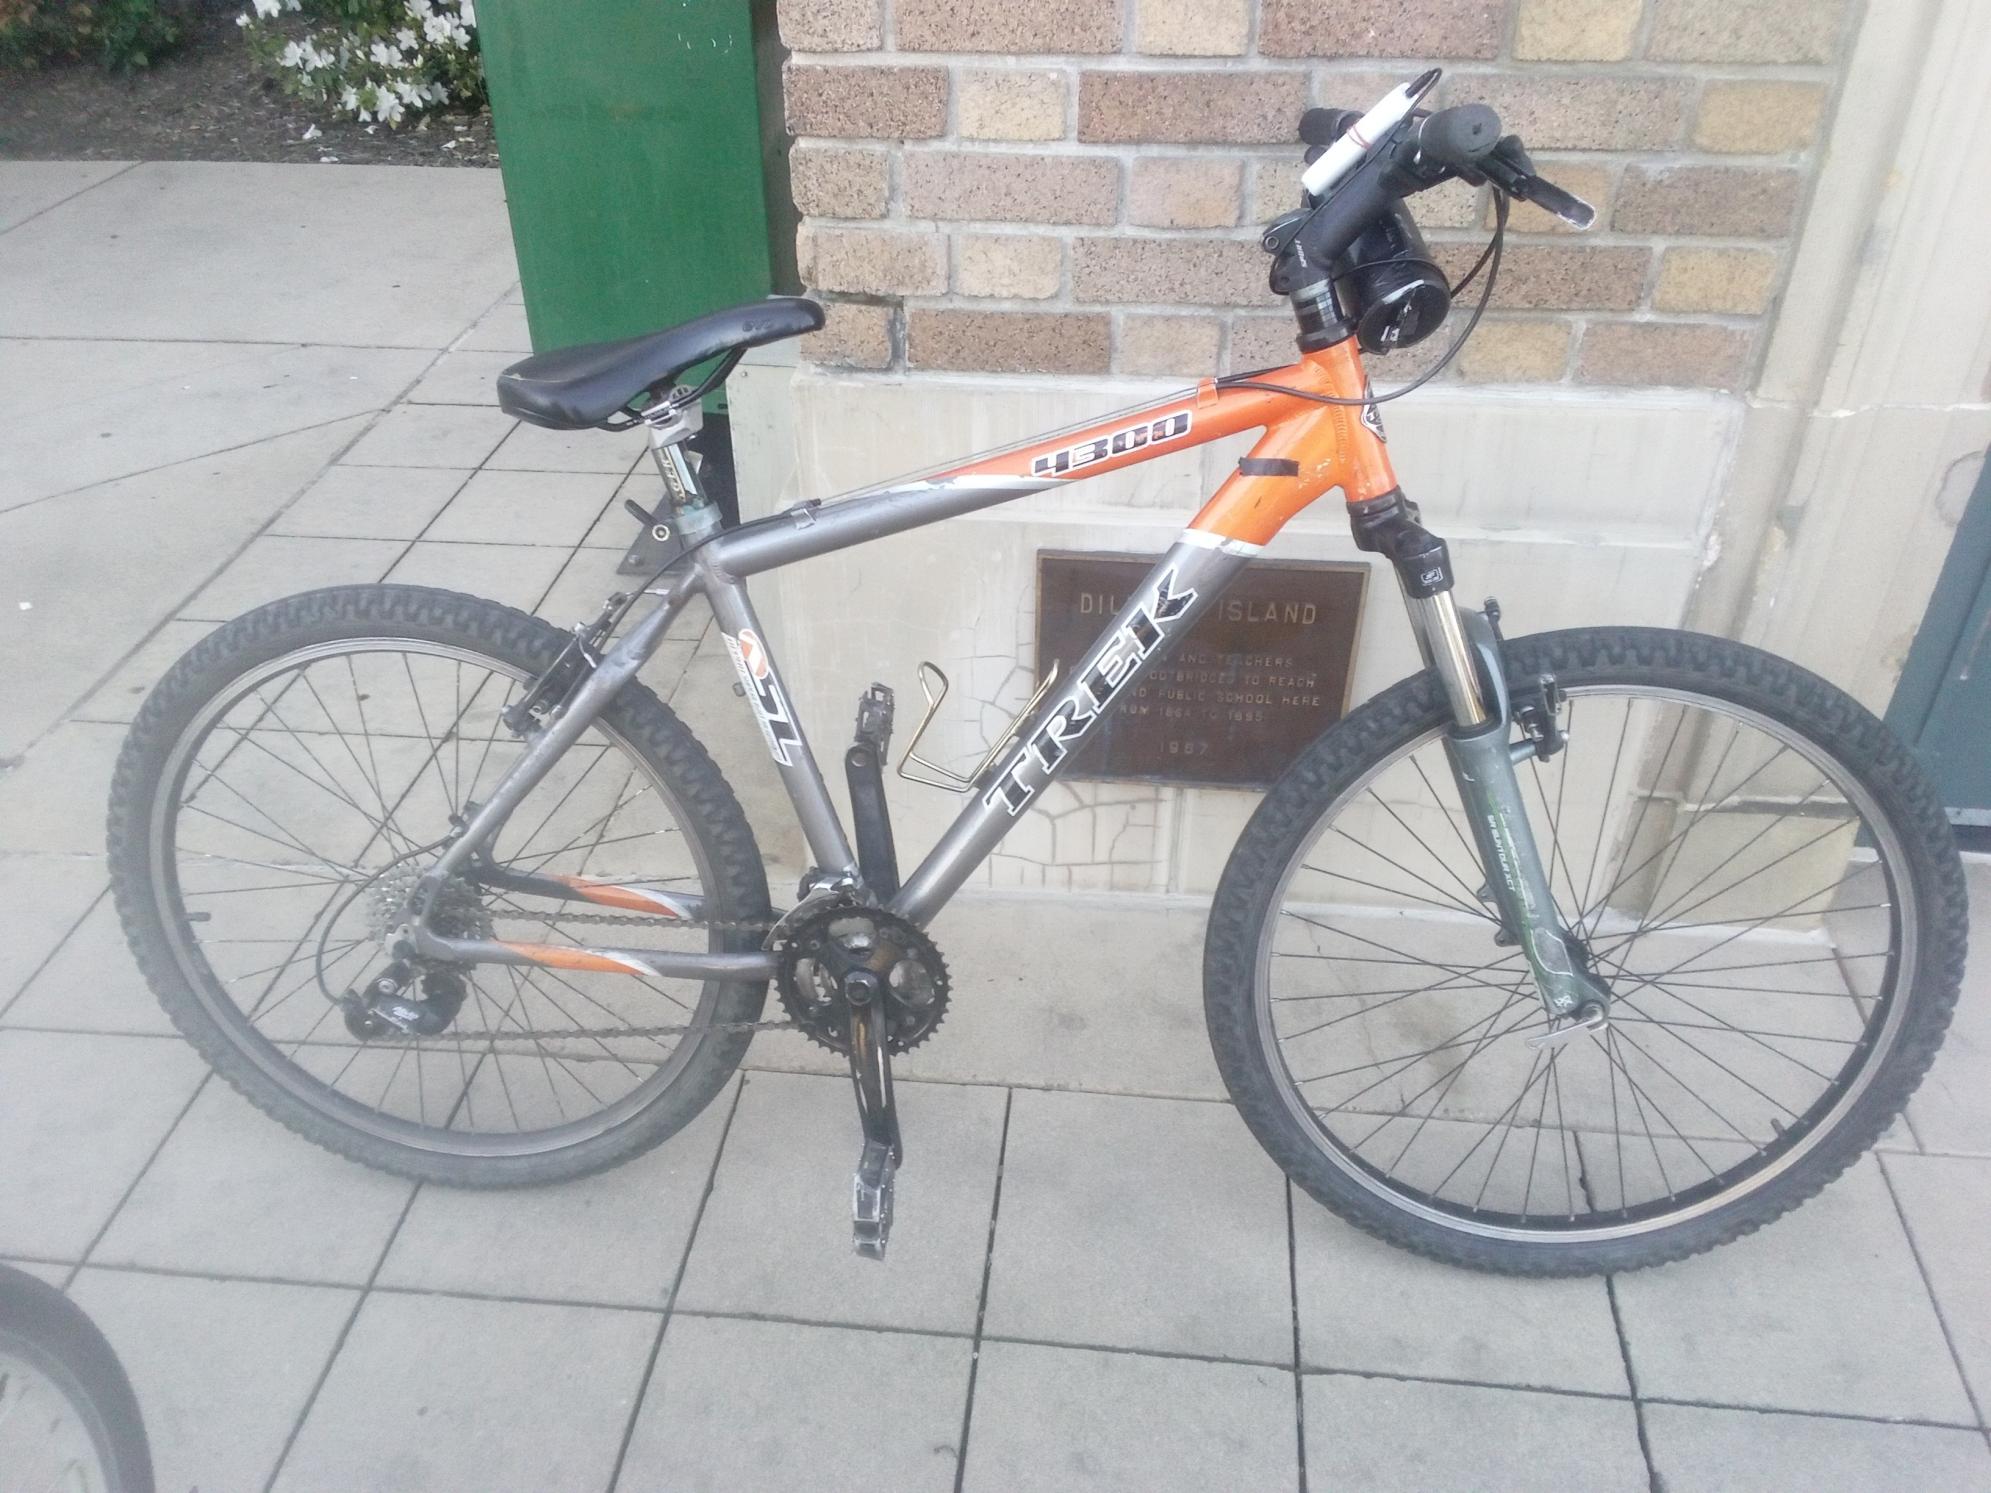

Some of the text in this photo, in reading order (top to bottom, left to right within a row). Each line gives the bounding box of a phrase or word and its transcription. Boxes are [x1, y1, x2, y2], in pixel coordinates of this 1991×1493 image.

[1031, 410, 1192, 477] 4300
[1217, 600, 1317, 625] ISLAND
[983, 562, 1198, 817] TREK
[1244, 674, 1260, 687] TO
[1268, 675, 1315, 689] REACH
[1158, 688, 1206, 703] PUBLIC
[1215, 690, 1273, 705] SCHOOL
[1280, 695, 1321, 707] HERE
